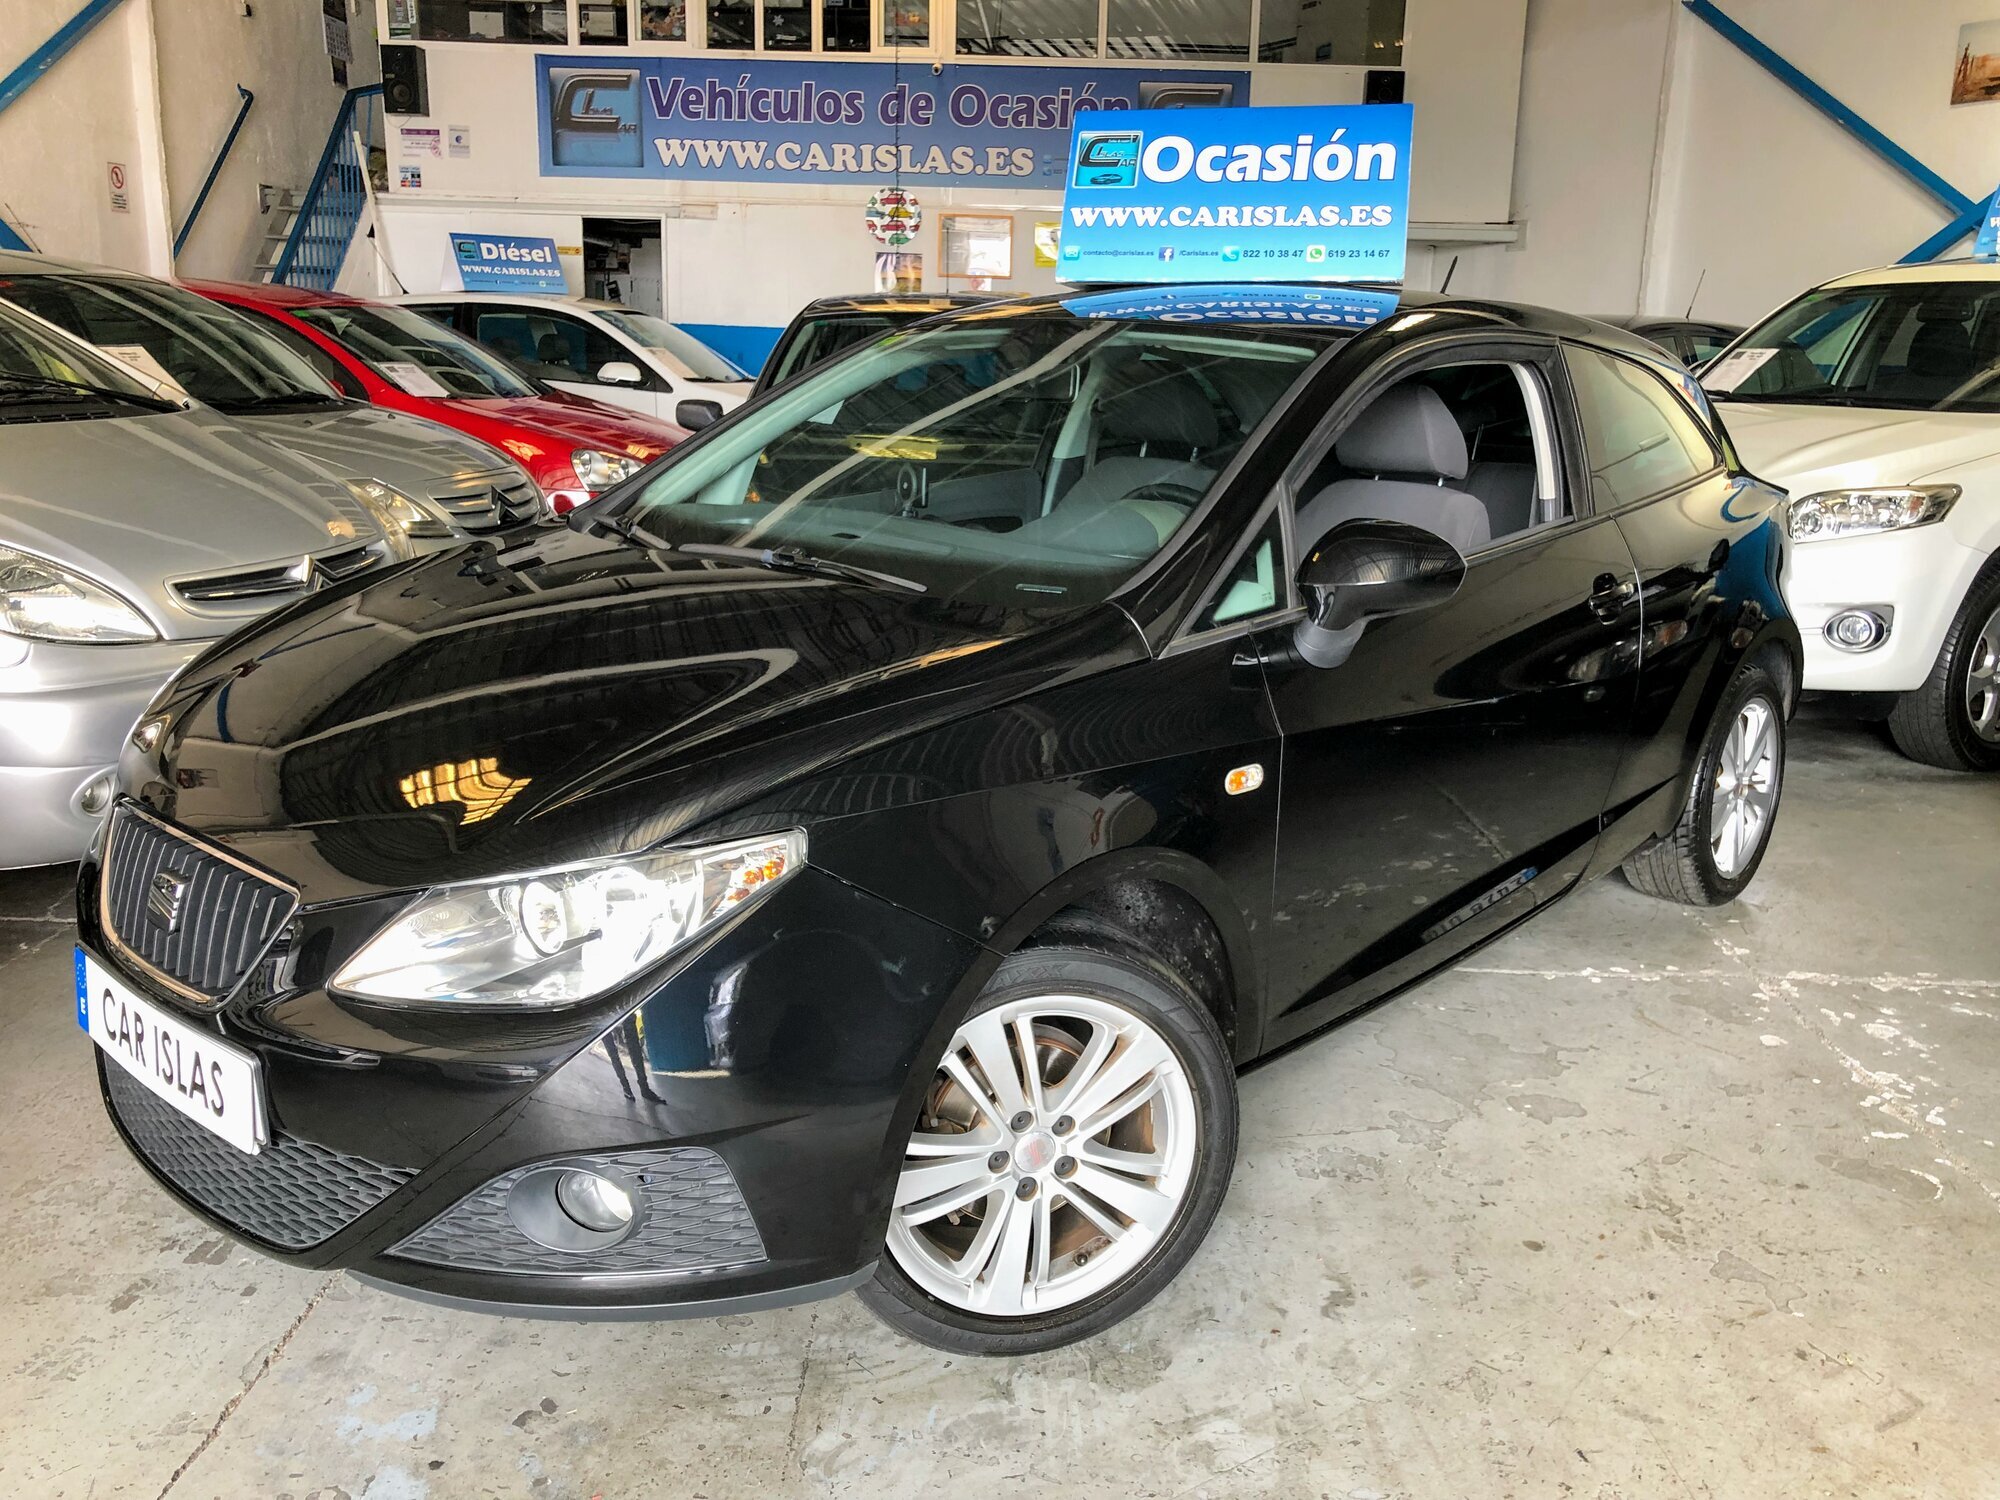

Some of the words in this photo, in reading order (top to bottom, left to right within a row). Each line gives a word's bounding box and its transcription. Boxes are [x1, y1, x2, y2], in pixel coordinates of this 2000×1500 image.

[646, 74, 865, 125] Vehículos
[878, 83, 936, 126] de
[653, 137, 1034, 177] WWW.CARISLAS.ES
[1142, 128, 1397, 183] Ocasión
[1070, 205, 1393, 228] WWW.CARISLAS.ES
[479, 241, 553, 263] Diésel
[1083, 249, 1154, 257] contacto@carislas.es
[1242, 249, 1260, 258] 822
[1263, 249, 1275, 258] 10
[1277, 249, 1289, 258] 38
[1291, 249, 1304, 258] 47
[1327, 249, 1346, 258] 619
[1348, 249, 1361, 258] 23
[1364, 249, 1375, 258] 14
[1378, 249, 1390, 258] 67
[461, 264, 561, 278] WWW.CARISLAS.ES
[102, 988, 146, 1068] CAR
[153, 1025, 224, 1118] ISLAS
